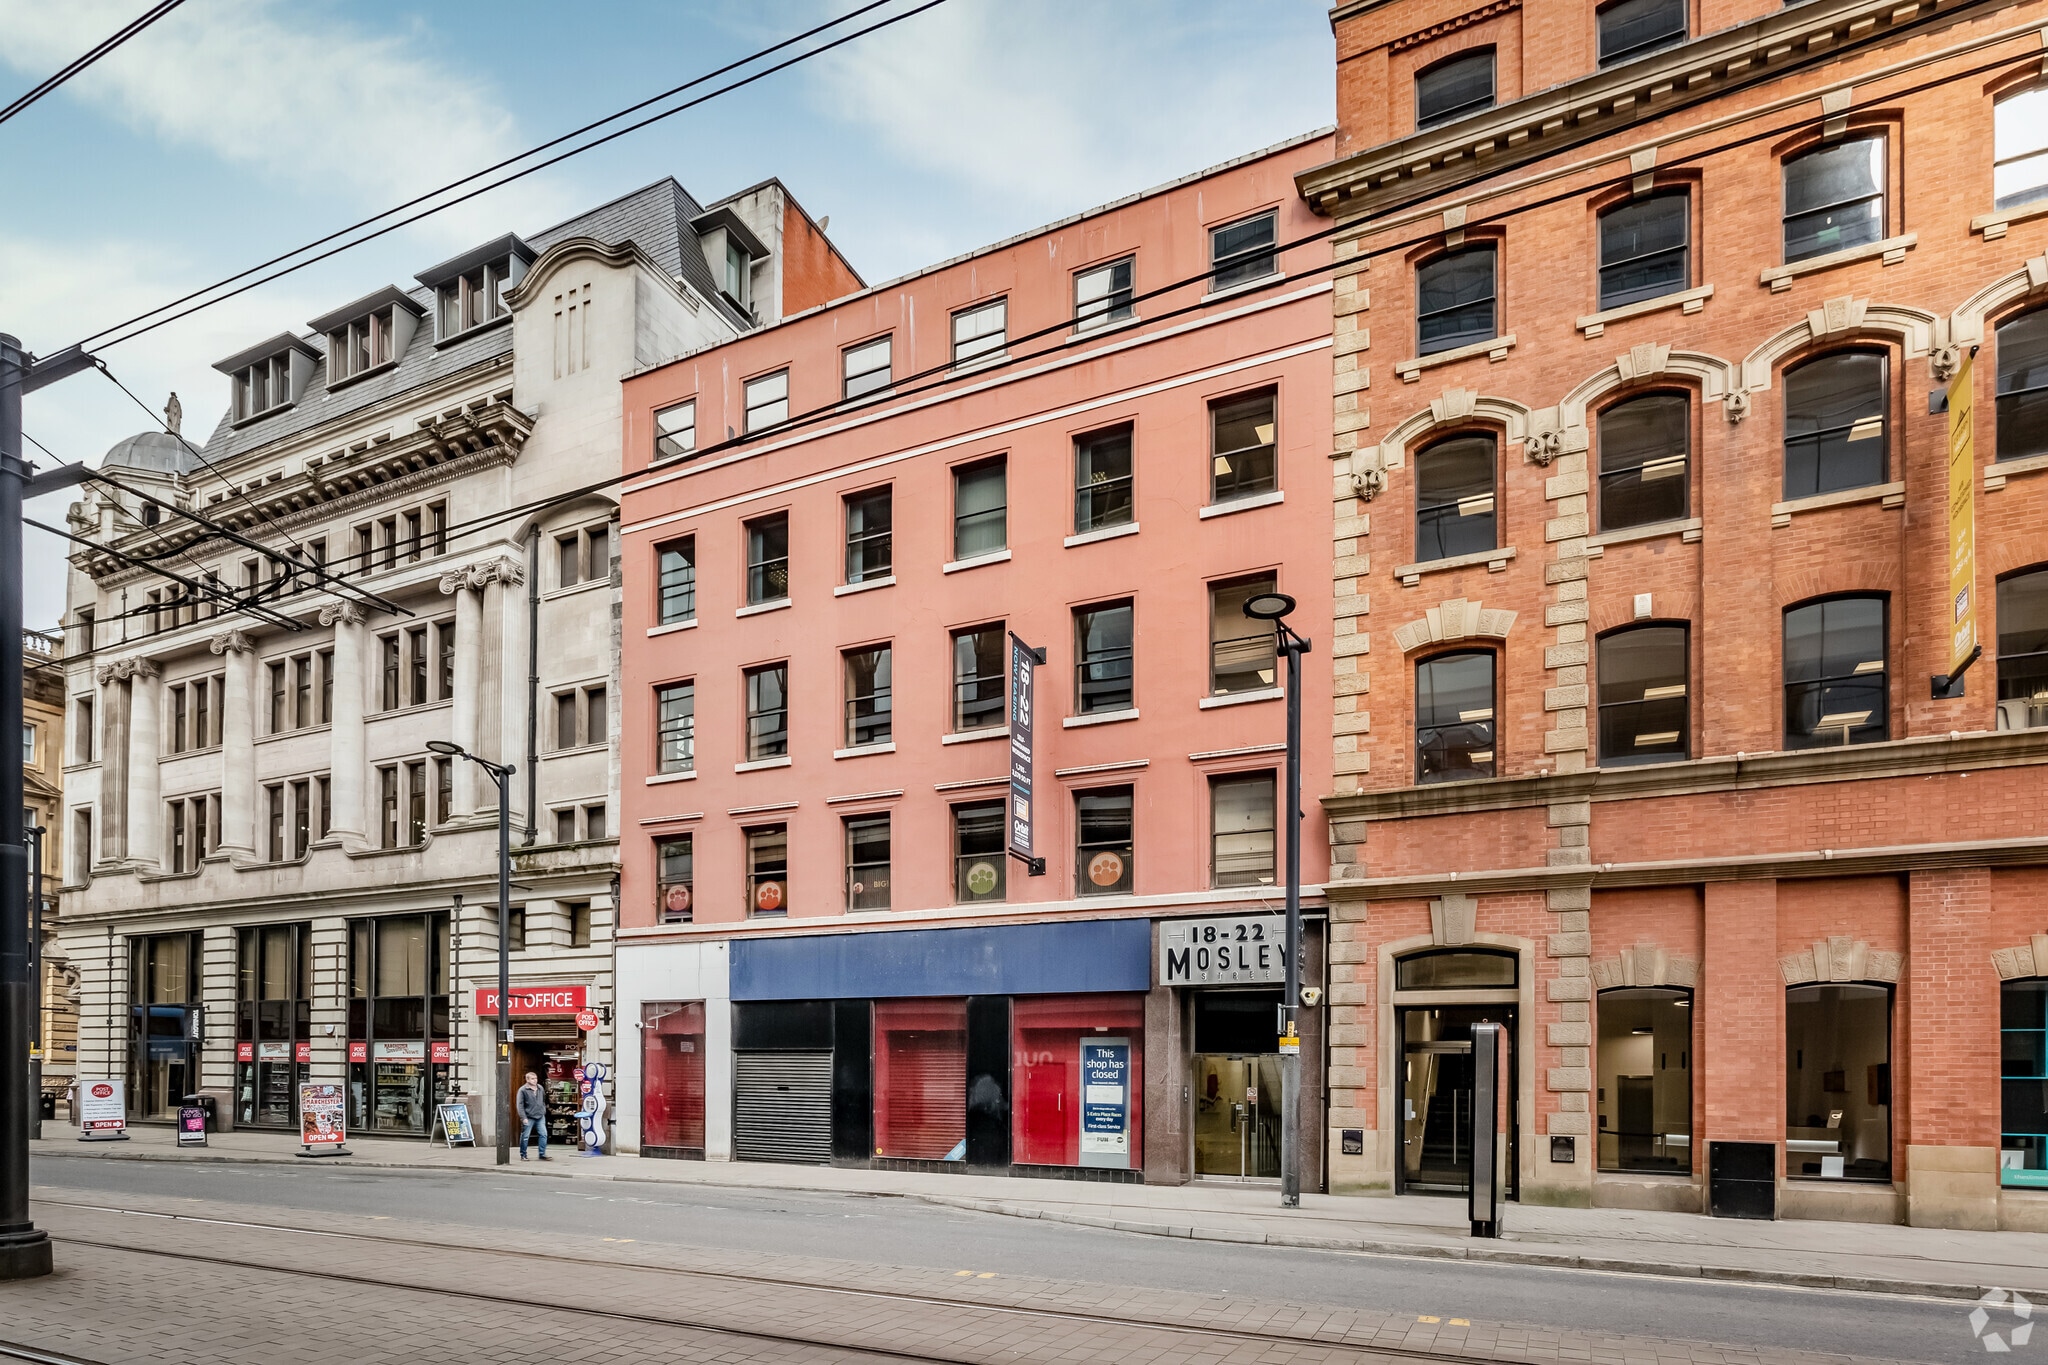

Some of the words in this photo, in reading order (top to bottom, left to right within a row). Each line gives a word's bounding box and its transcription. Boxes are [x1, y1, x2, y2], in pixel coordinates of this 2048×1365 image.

[1014, 820, 1029, 836] Orbit
[1192, 923, 1264, 943] 18-22
[1168, 944, 1286, 980] MOSLEY
[1201, 970, 1286, 981] STREET
[524, 993, 573, 1008] OFFICE
[1097, 1049, 1114, 1058] This
[1087, 1060, 1107, 1070] shop
[1109, 1060, 1124, 1068] has
[1092, 1070, 1118, 1079] closed
[443, 1110, 466, 1121] VAPE
